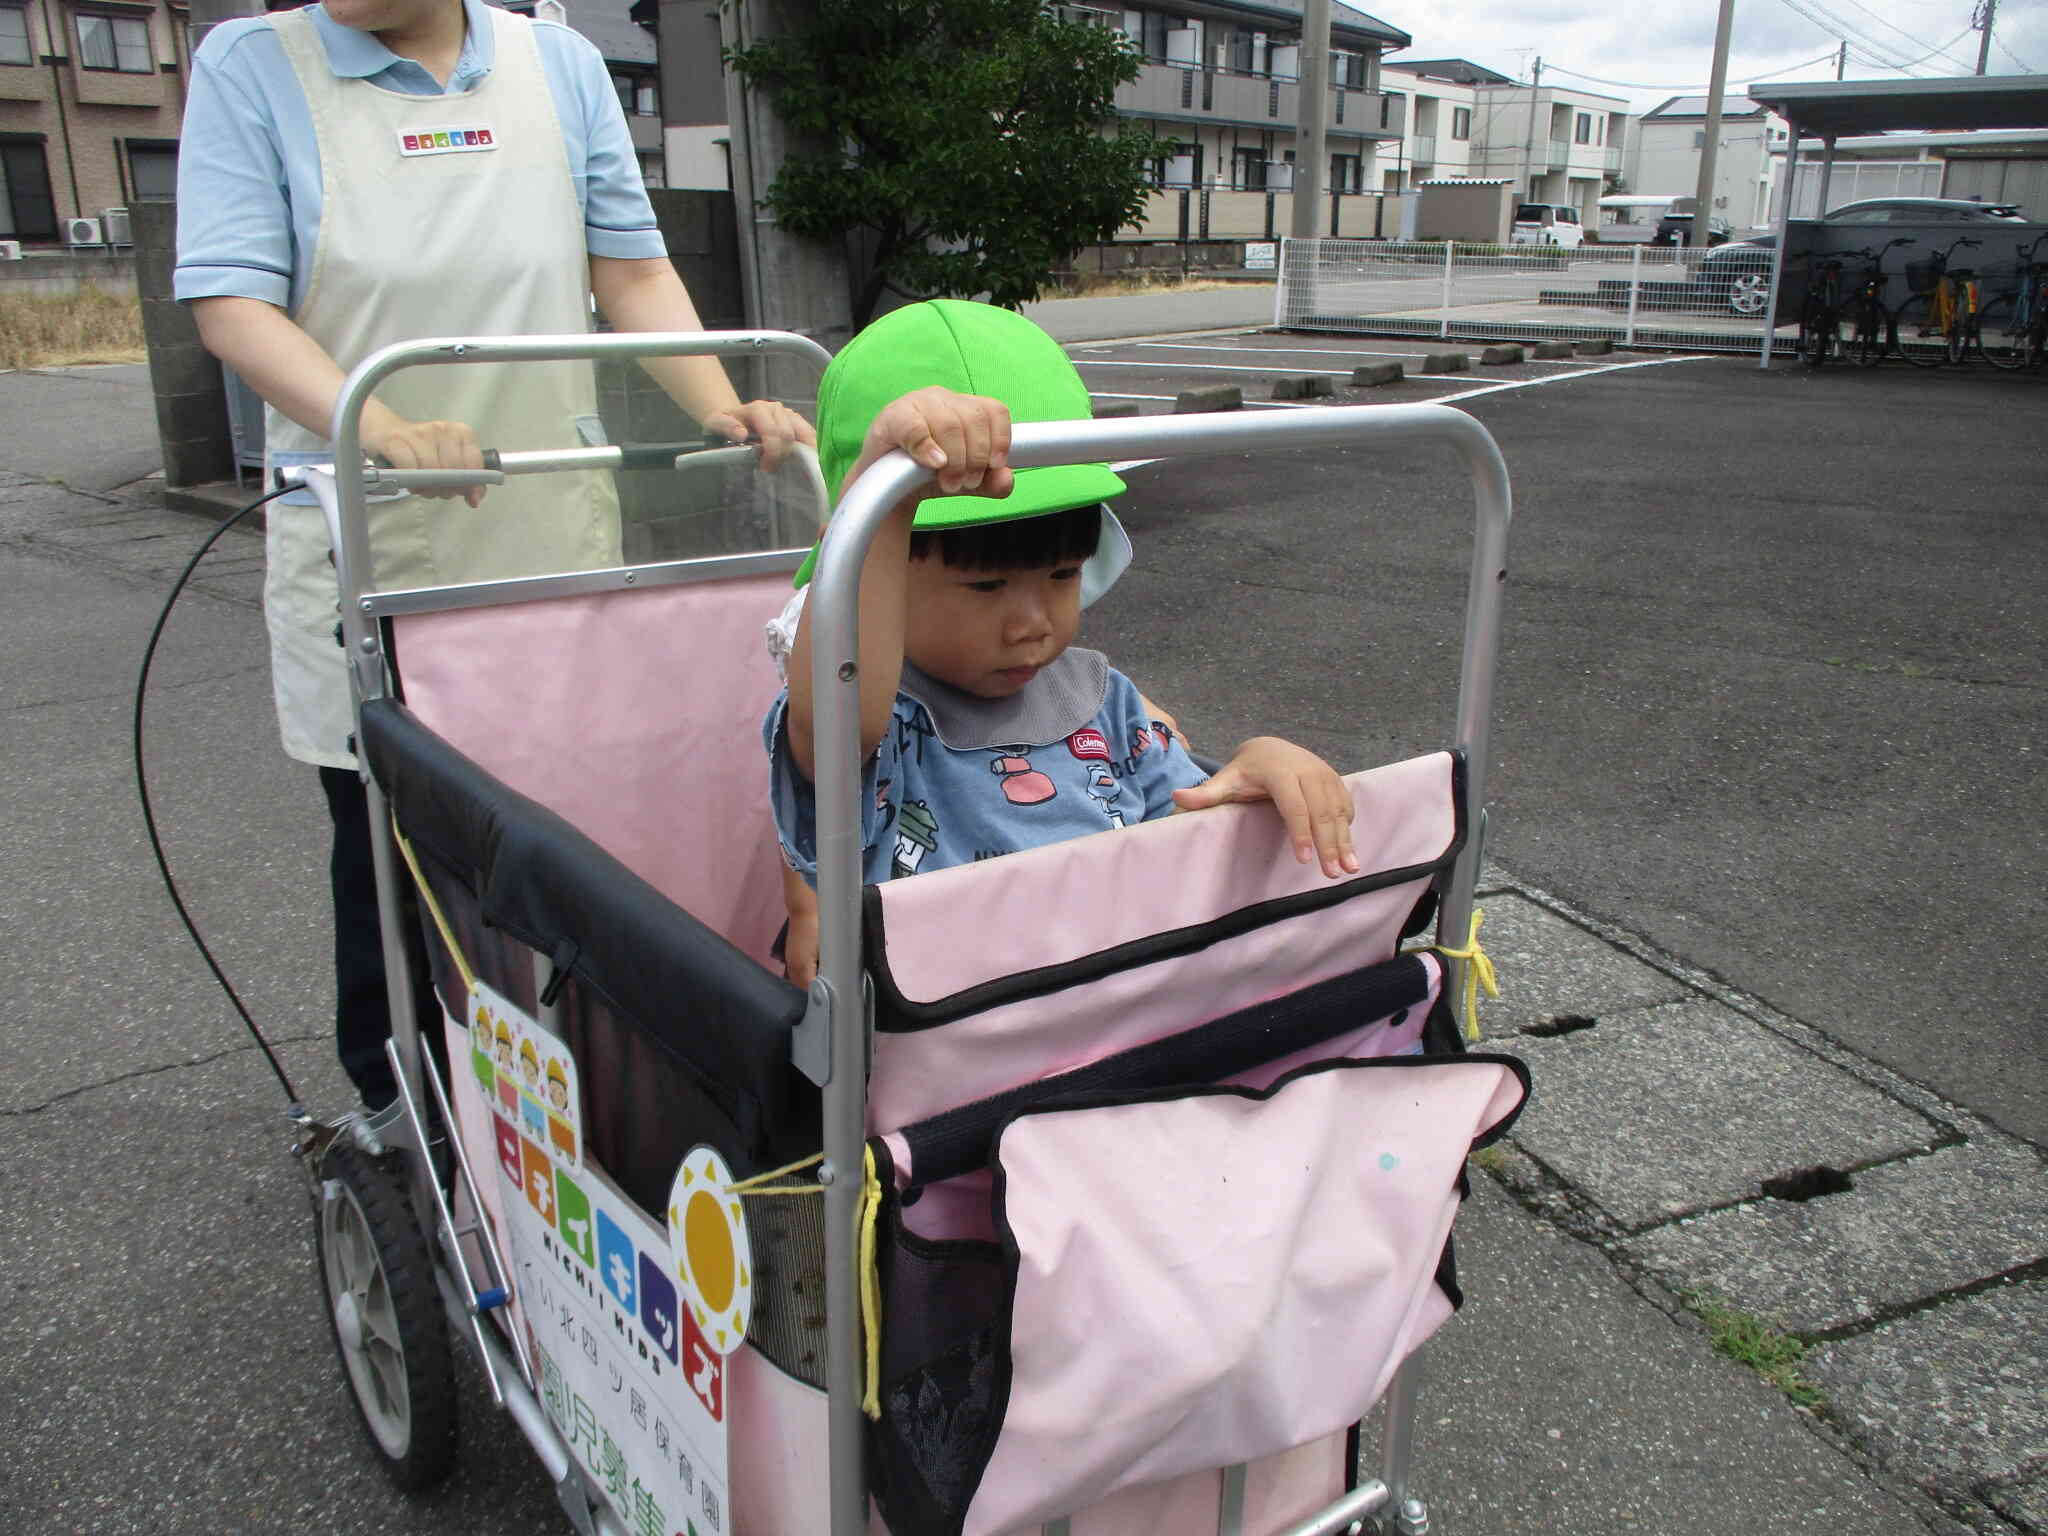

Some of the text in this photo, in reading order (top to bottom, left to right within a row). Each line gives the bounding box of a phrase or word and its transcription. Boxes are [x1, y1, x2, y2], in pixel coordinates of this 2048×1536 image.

[500, 1138, 721, 1414] ニチイキッズ
[543, 1230, 661, 1377] NICHII KIDS
